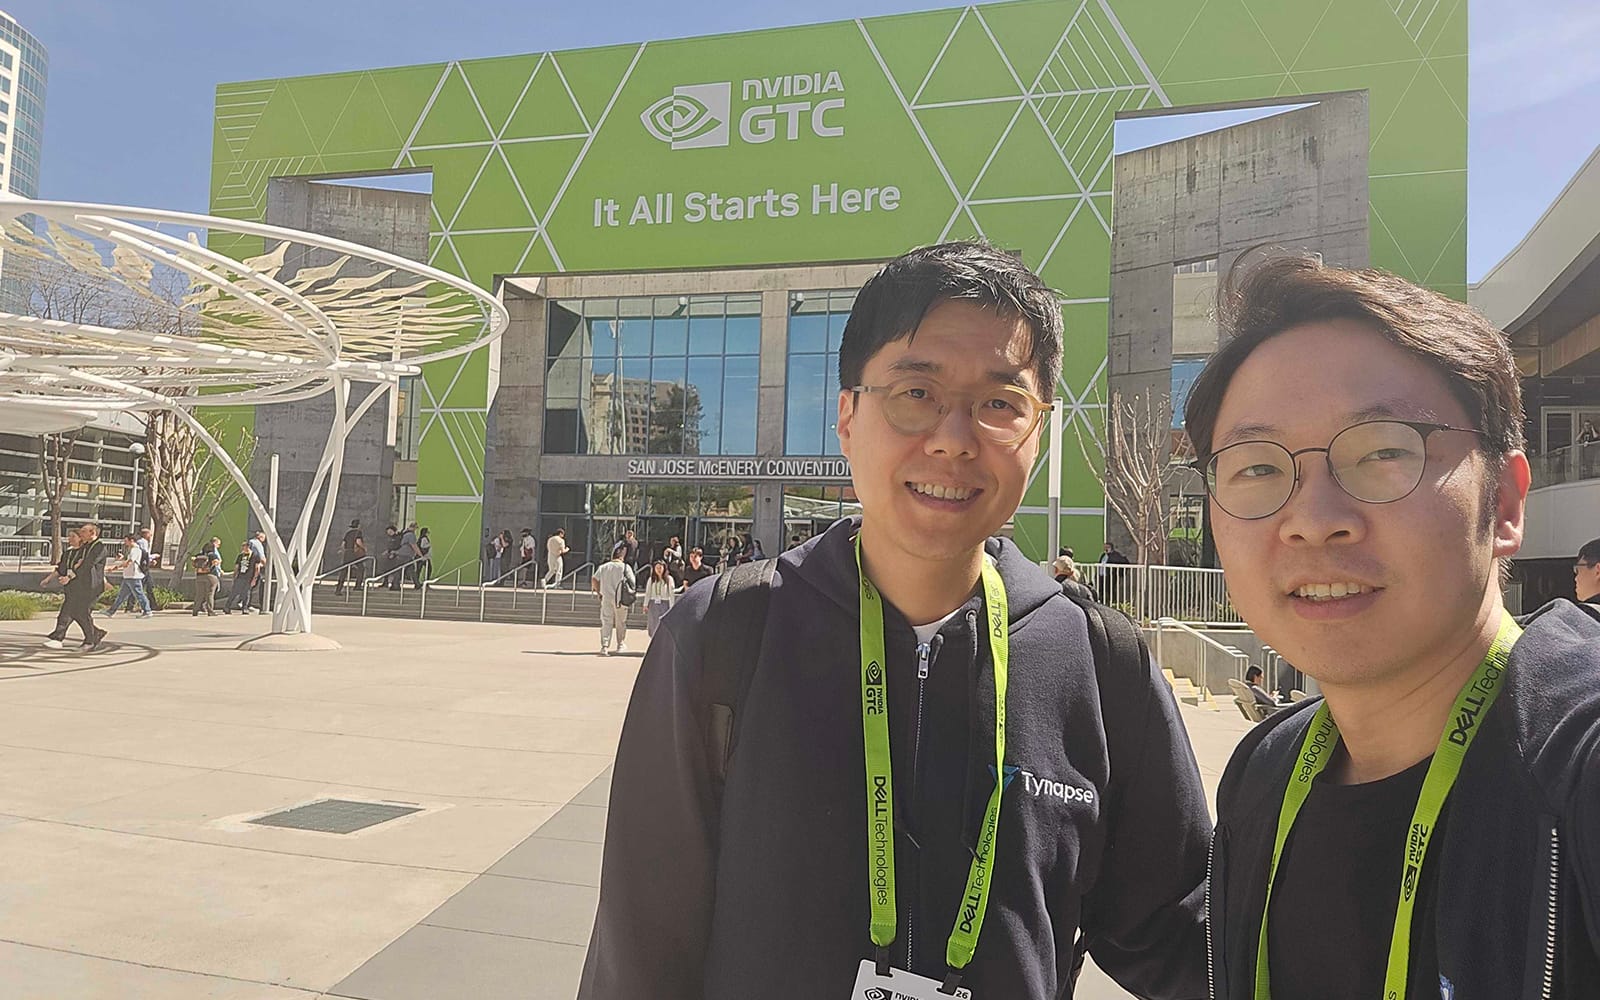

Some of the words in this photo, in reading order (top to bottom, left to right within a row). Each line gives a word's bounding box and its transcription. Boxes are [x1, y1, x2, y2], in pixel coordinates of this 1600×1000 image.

[739, 98, 845, 143] GTC
[593, 198, 619, 227] It
[628, 193, 672, 225] All
[683, 189, 800, 222] Starts
[812, 183, 901, 214] Here
[627, 460, 655, 475] SAN
[659, 460, 695, 475] JOSE
[698, 460, 763, 475] McENERY
[766, 460, 849, 476] CONVENTIO
[991, 602, 1003, 639] DELL
[866, 688, 877, 715] GTC
[1448, 697, 1486, 747] DELL
[873, 776, 886, 816] DELL
[1021, 771, 1094, 804] Tynapse
[873, 817, 888, 906] Technologies
[1415, 824, 1429, 864] GTC
[959, 893, 982, 934] DELL
